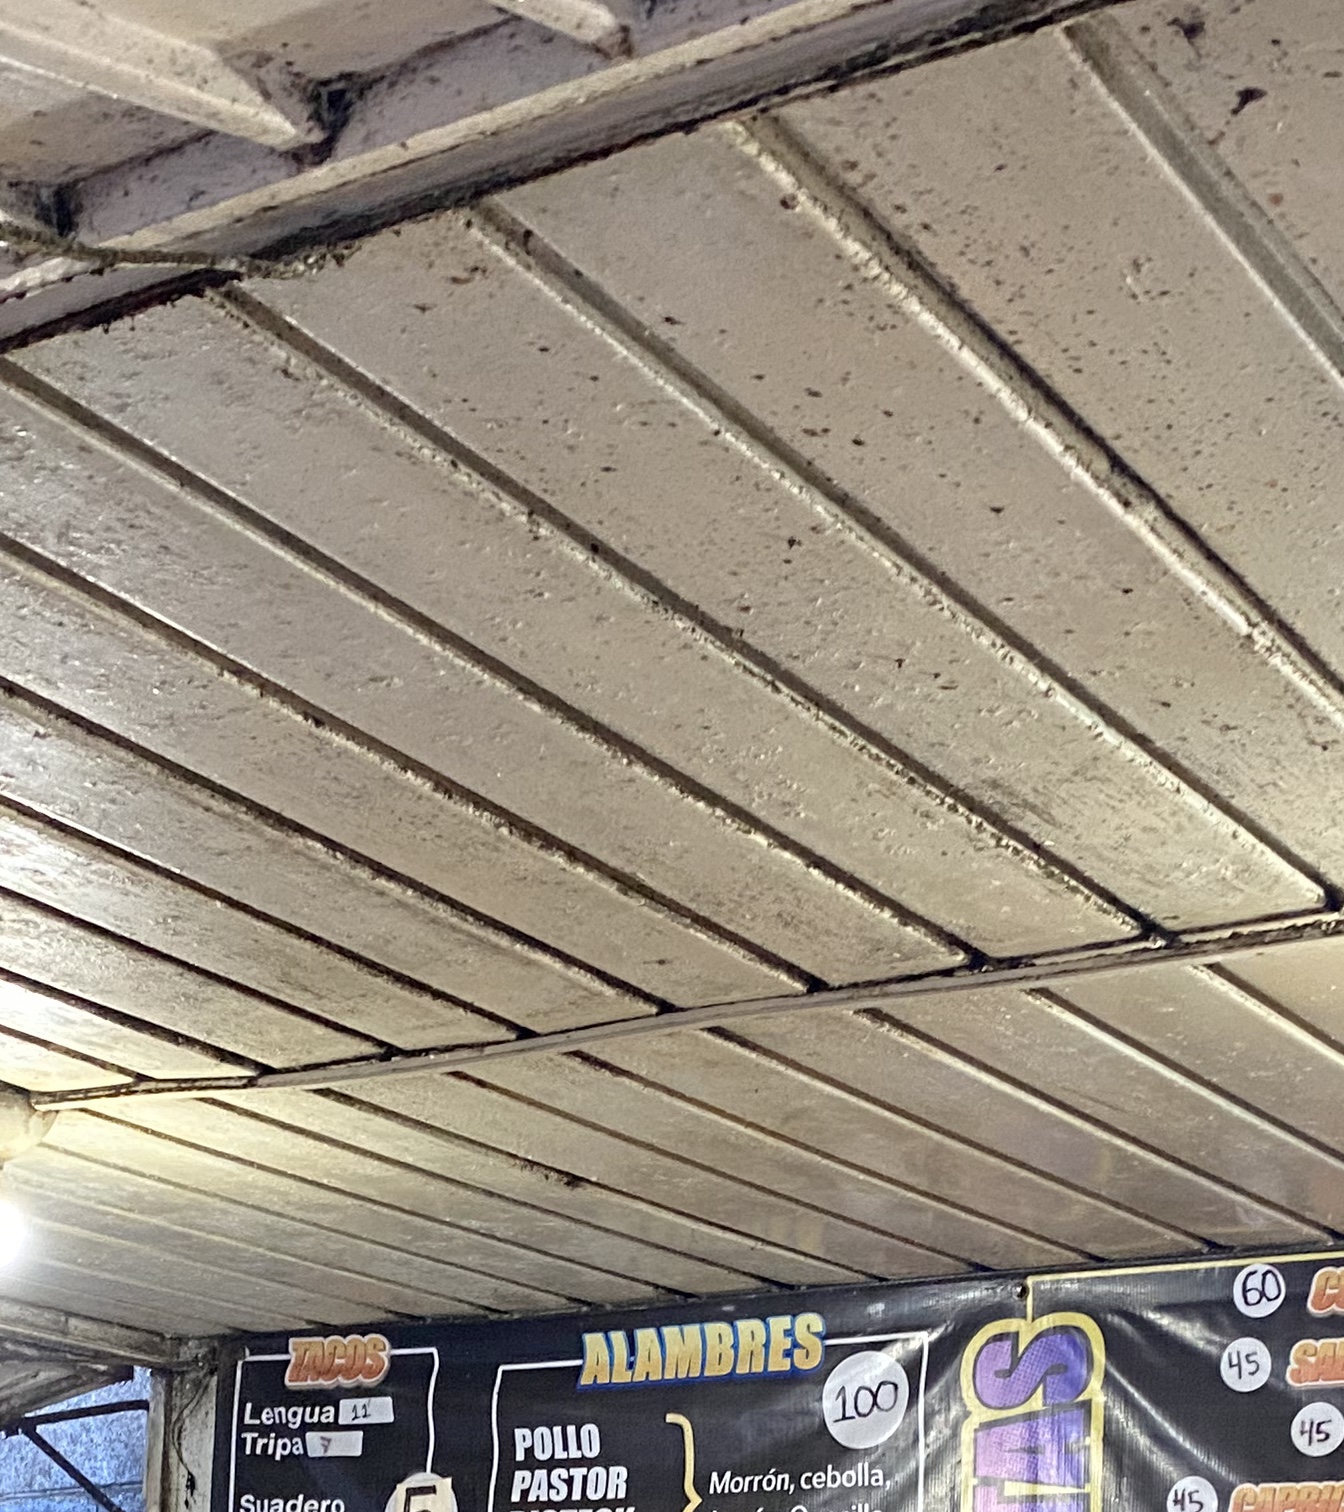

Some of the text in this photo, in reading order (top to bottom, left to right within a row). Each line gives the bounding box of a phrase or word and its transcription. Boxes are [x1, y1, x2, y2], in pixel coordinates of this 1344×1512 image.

[1241, 1270, 1282, 1307] 60
[287, 1334, 389, 1386] TACOS
[578, 1311, 826, 1388] ALAMBRES
[1228, 1349, 1262, 1379] 45
[243, 1402, 335, 1428] Lengua
[833, 1380, 898, 1423] 100
[241, 1432, 304, 1461] Tripa
[514, 1423, 600, 1461] POLLO
[1299, 1418, 1333, 1441] 45
[511, 1466, 628, 1502] PASTOR
[709, 1463, 891, 1496] Morrón, cebolla,
